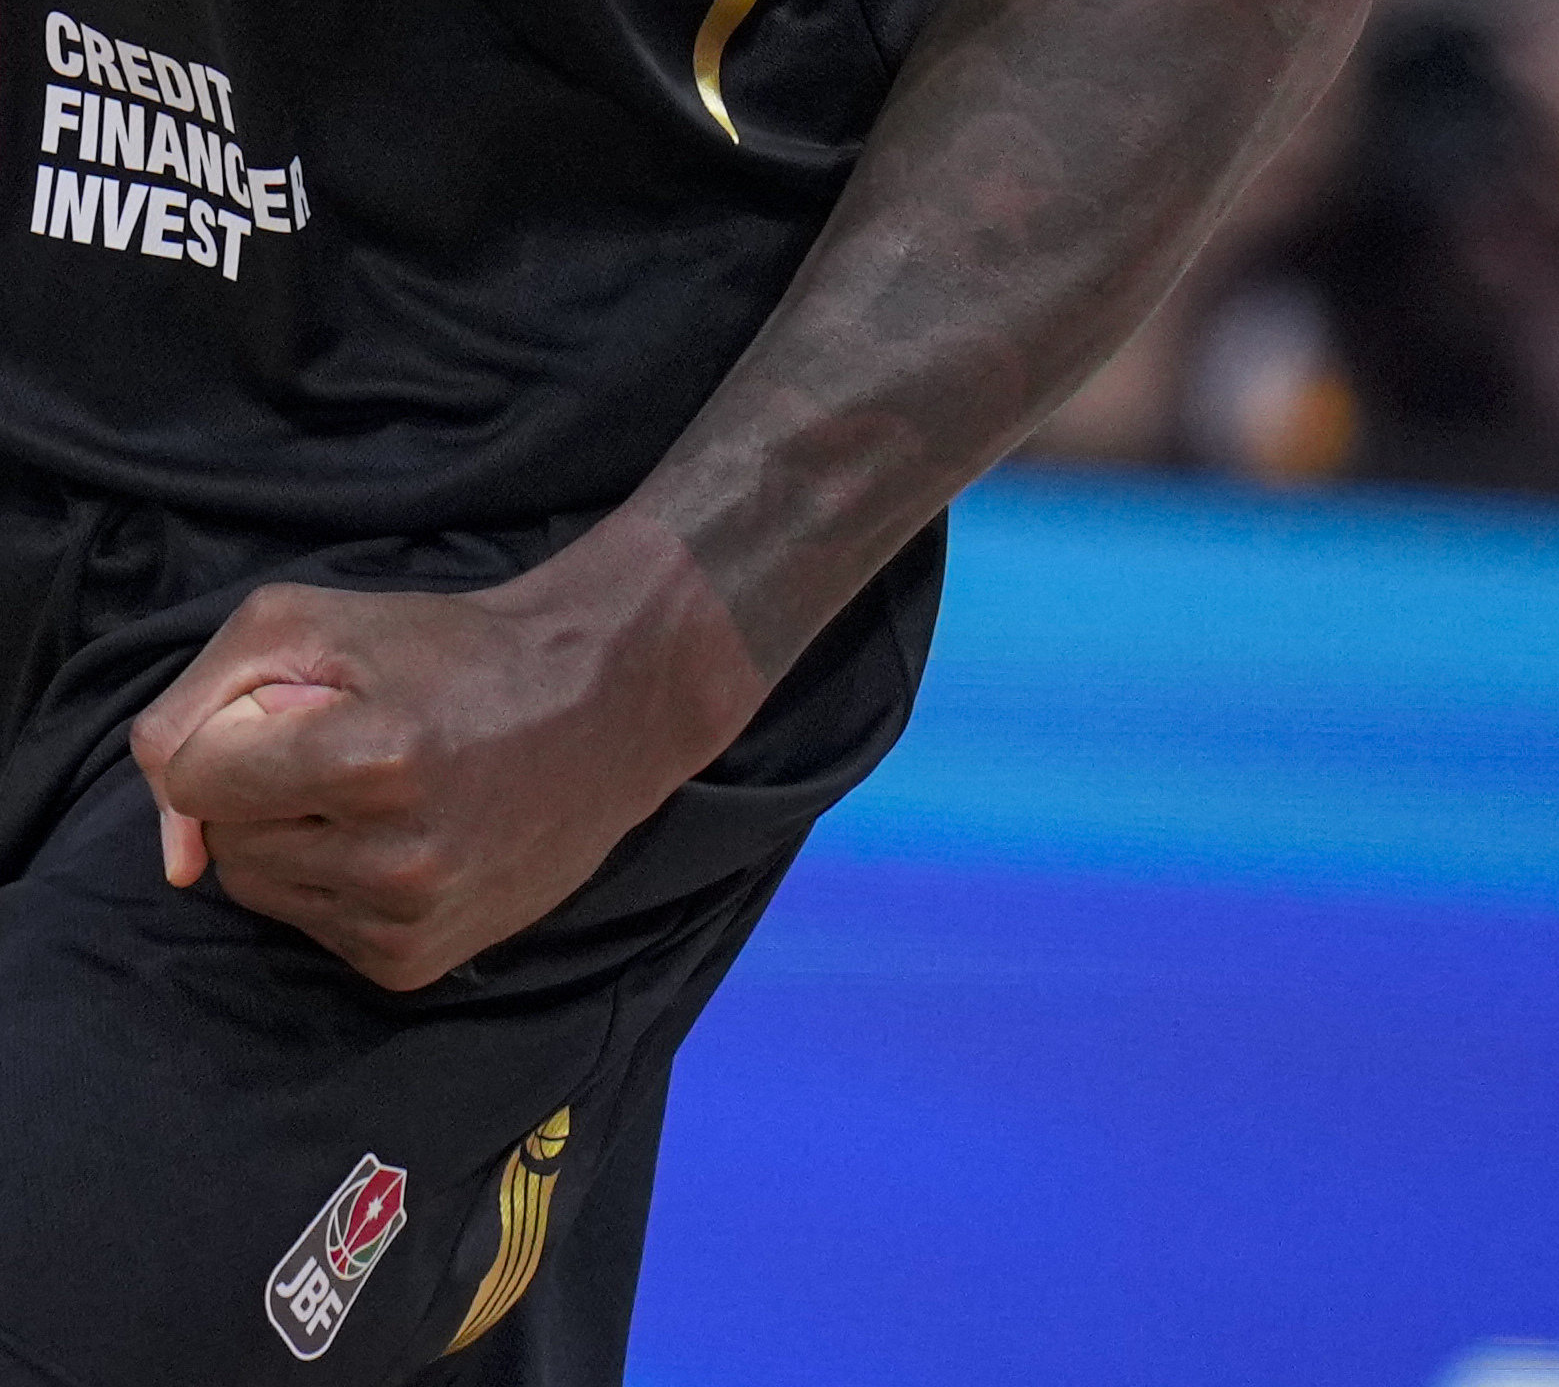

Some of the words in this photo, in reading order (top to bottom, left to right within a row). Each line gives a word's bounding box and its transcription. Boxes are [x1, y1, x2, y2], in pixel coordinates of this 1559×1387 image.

[45, 10, 236, 134] CREDIT
[30, 164, 252, 282] INVEST
[276, 1256, 343, 1336] JBF
